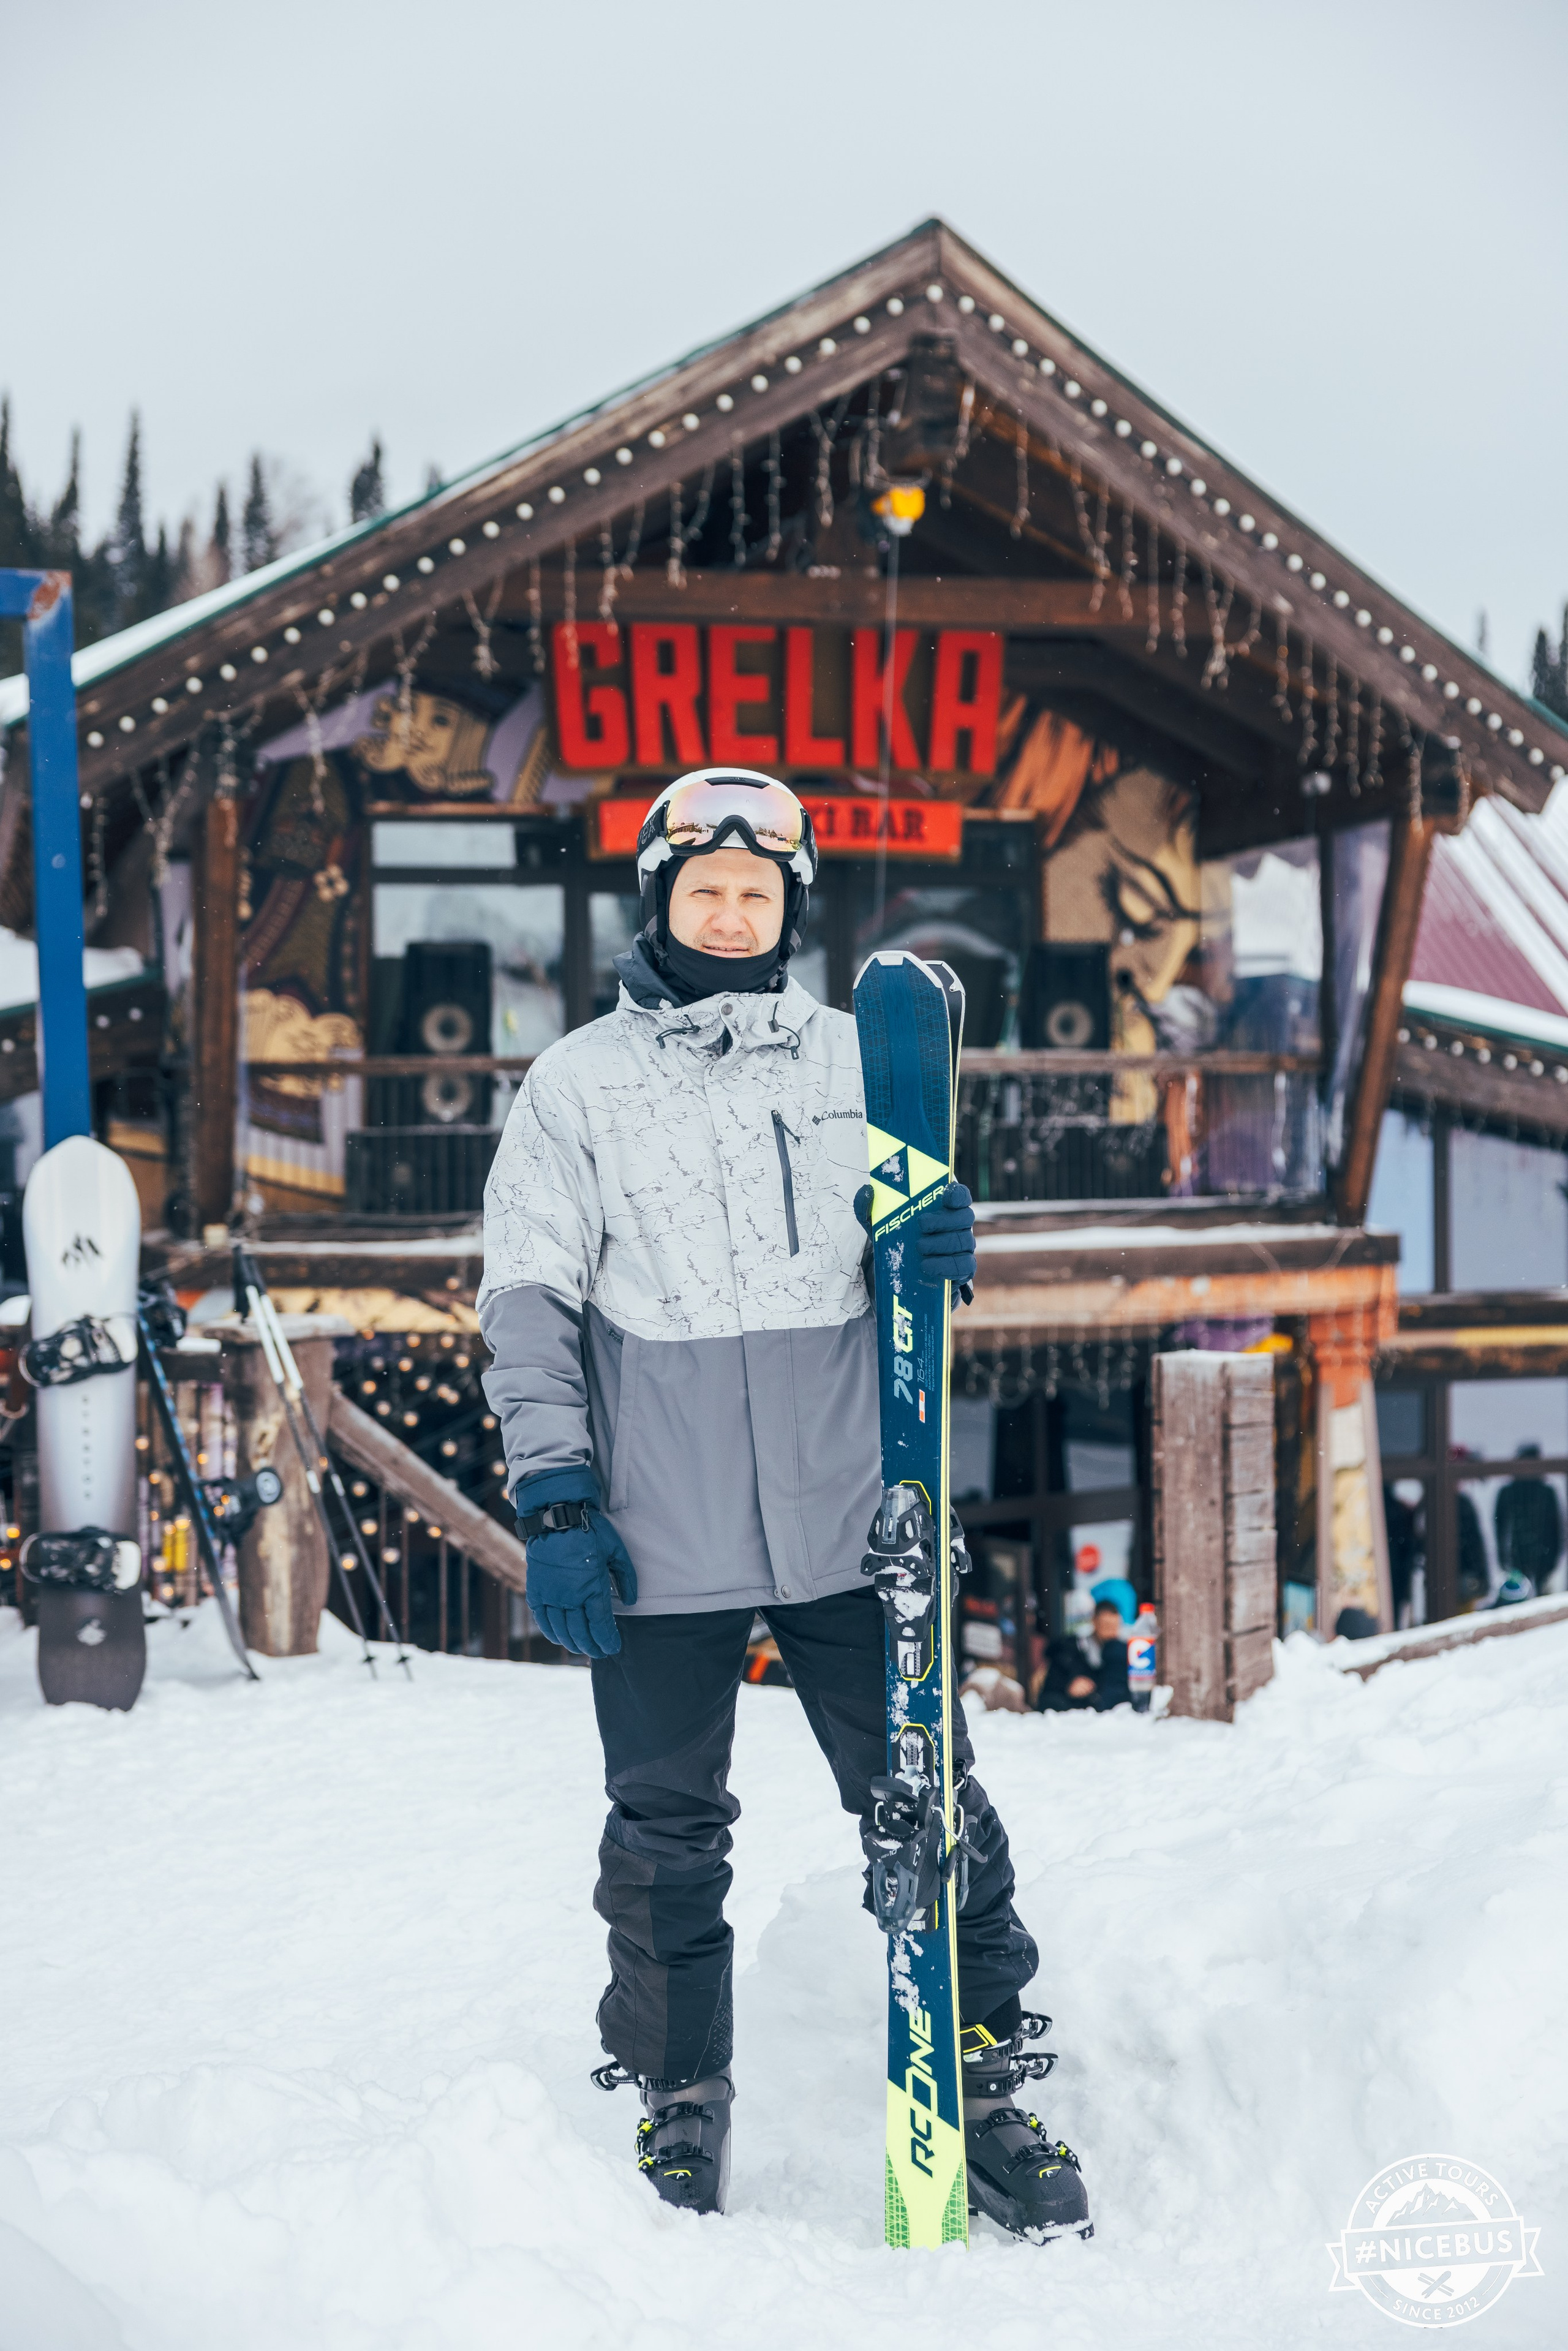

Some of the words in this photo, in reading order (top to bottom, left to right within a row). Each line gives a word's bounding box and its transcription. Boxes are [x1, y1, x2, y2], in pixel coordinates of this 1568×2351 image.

[552, 621, 1005, 774] GRELKA
[850, 807, 925, 842] BAR
[821, 1109, 862, 1120] Columbia
[875, 1185, 945, 1242] FISCHER
[894, 1355, 913, 1405] 78
